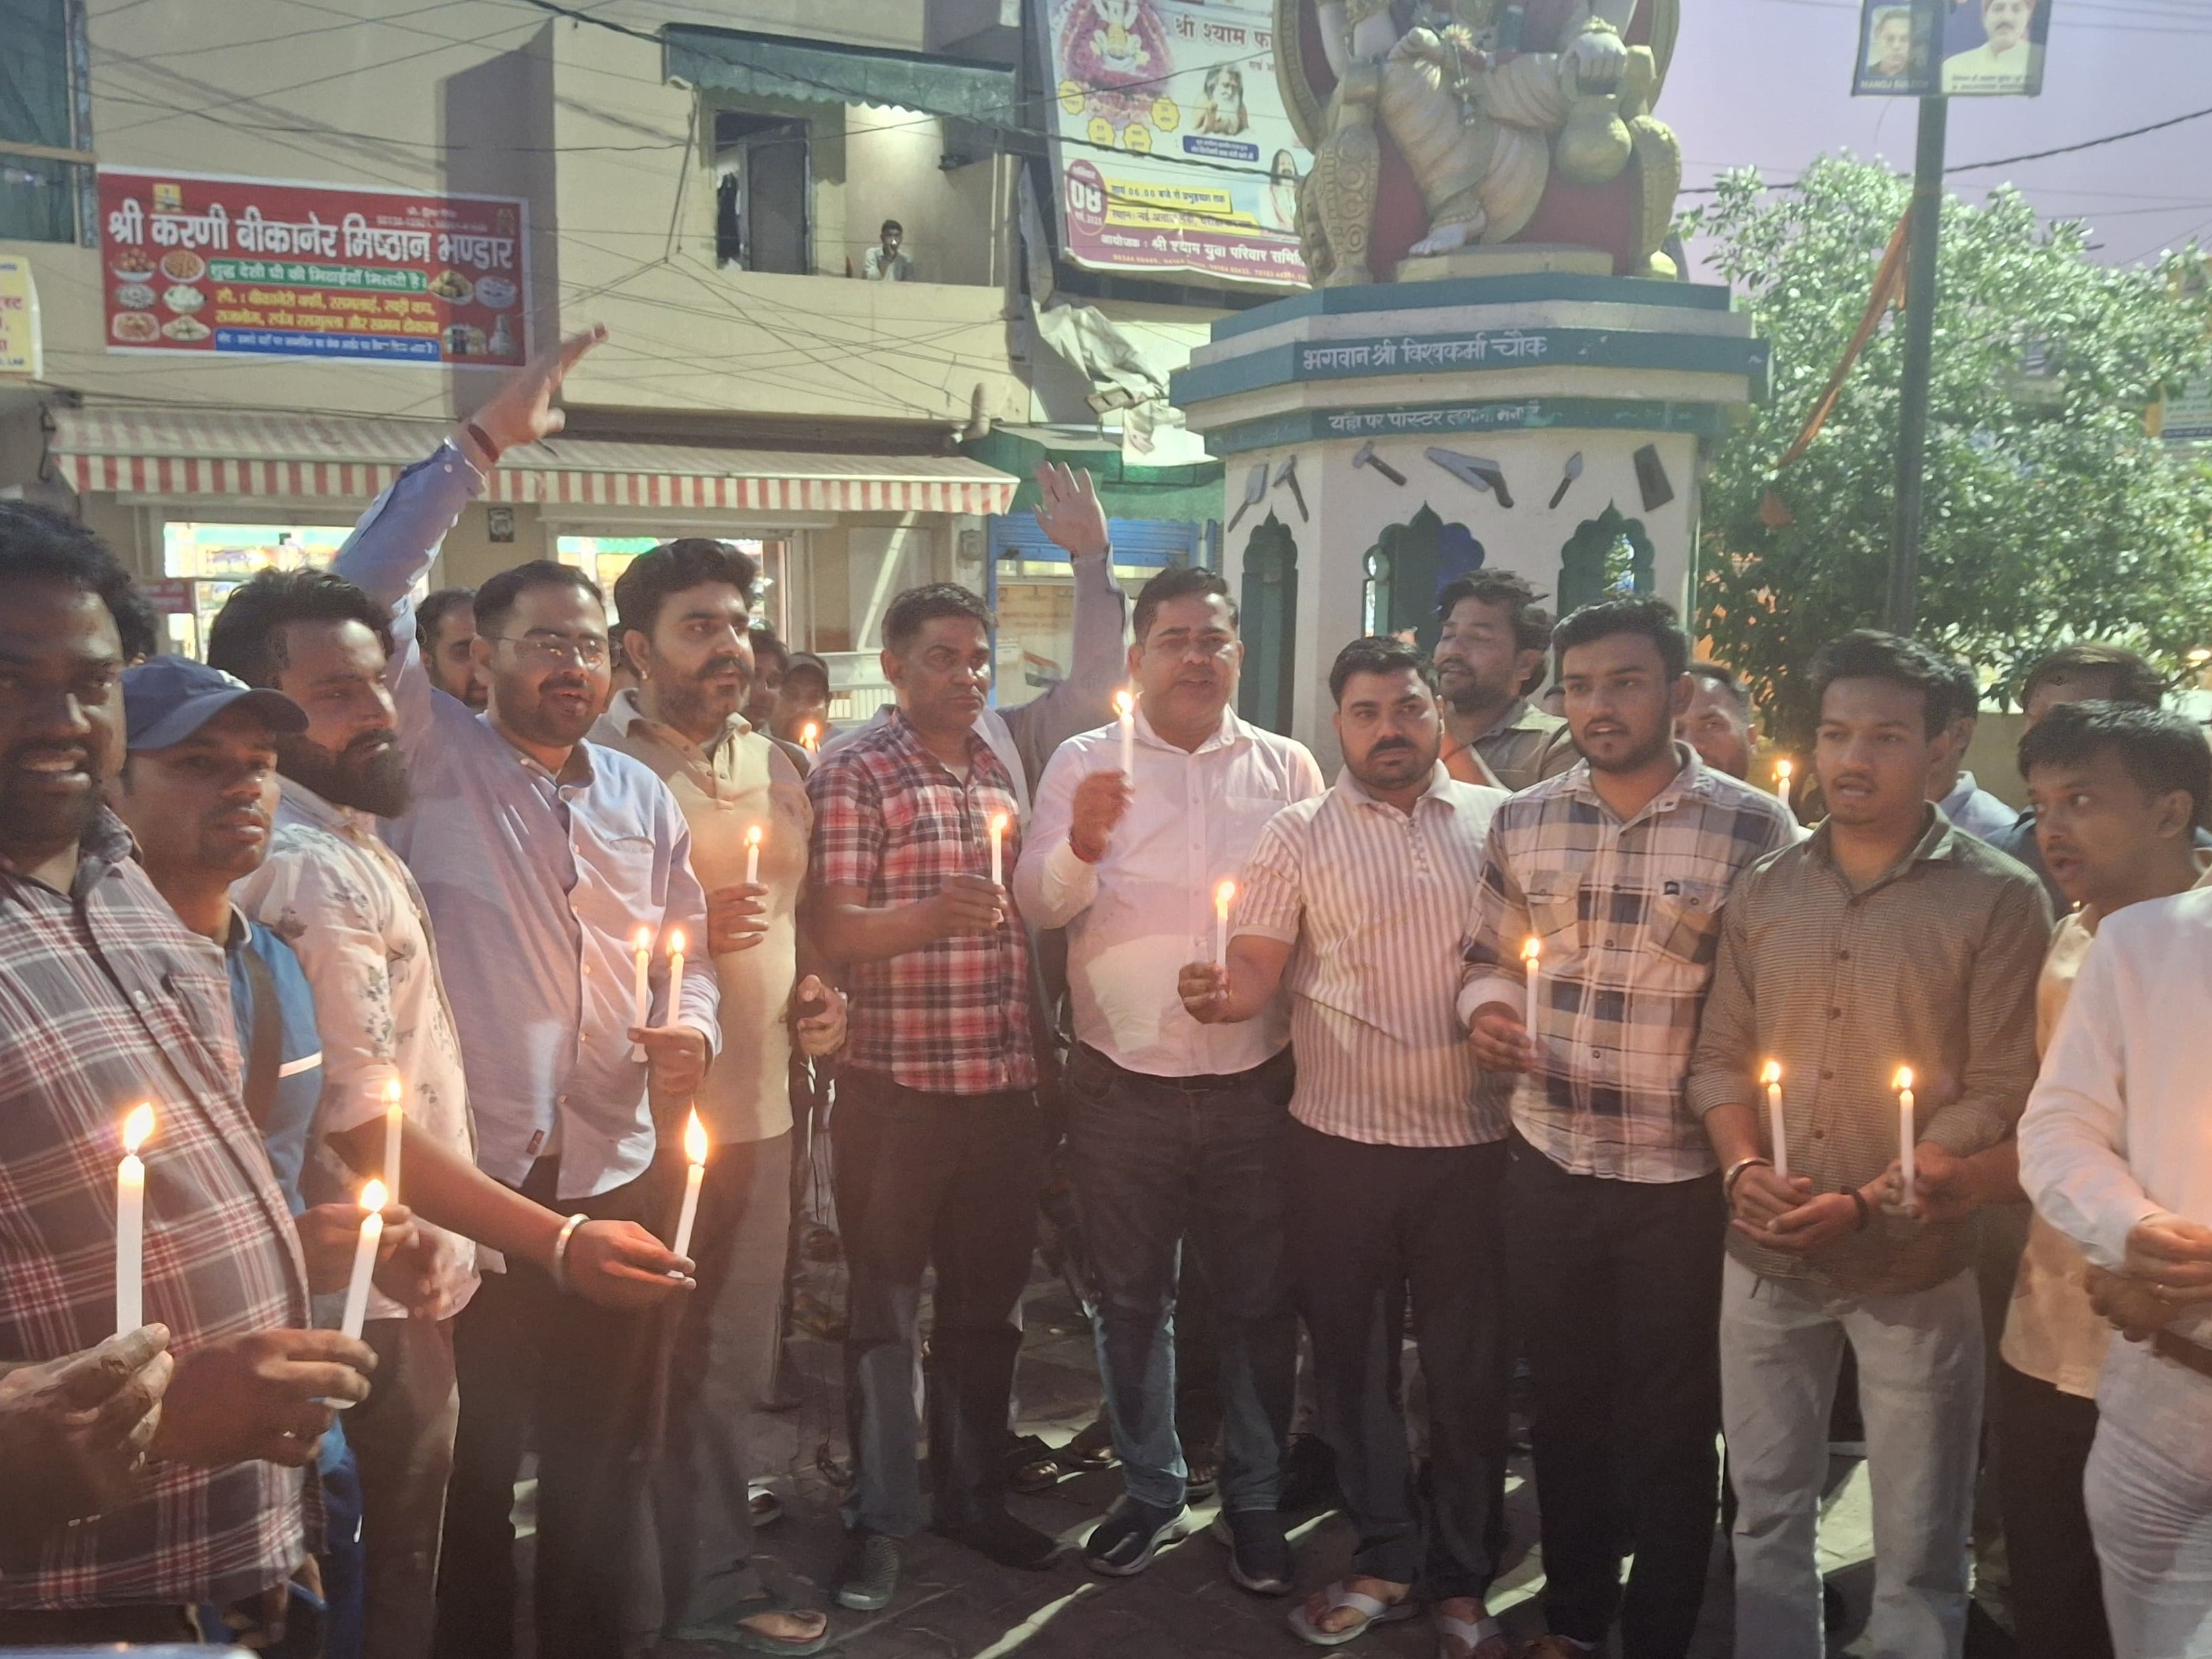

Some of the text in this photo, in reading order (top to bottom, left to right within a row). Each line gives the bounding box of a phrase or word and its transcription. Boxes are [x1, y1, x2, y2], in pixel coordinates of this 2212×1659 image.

[1175, 14, 1195, 37] श्री
[1203, 22, 1247, 45] श्याम
[108, 197, 514, 270] श्री करणी बीकानेर मिष्ठान भण्डार
[1101, 233, 1140, 248] आयोजक
[1151, 234, 1167, 252] श्री
[1169, 240, 1201, 255] श्याम
[1203, 243, 1226, 261] युवा
[1229, 243, 1267, 262] परिवार
[1303, 346, 1371, 370] भगवान
[1372, 338, 1397, 366] श्री
[1490, 330, 1548, 358] चौक
[1363, 413, 1385, 429] पर
